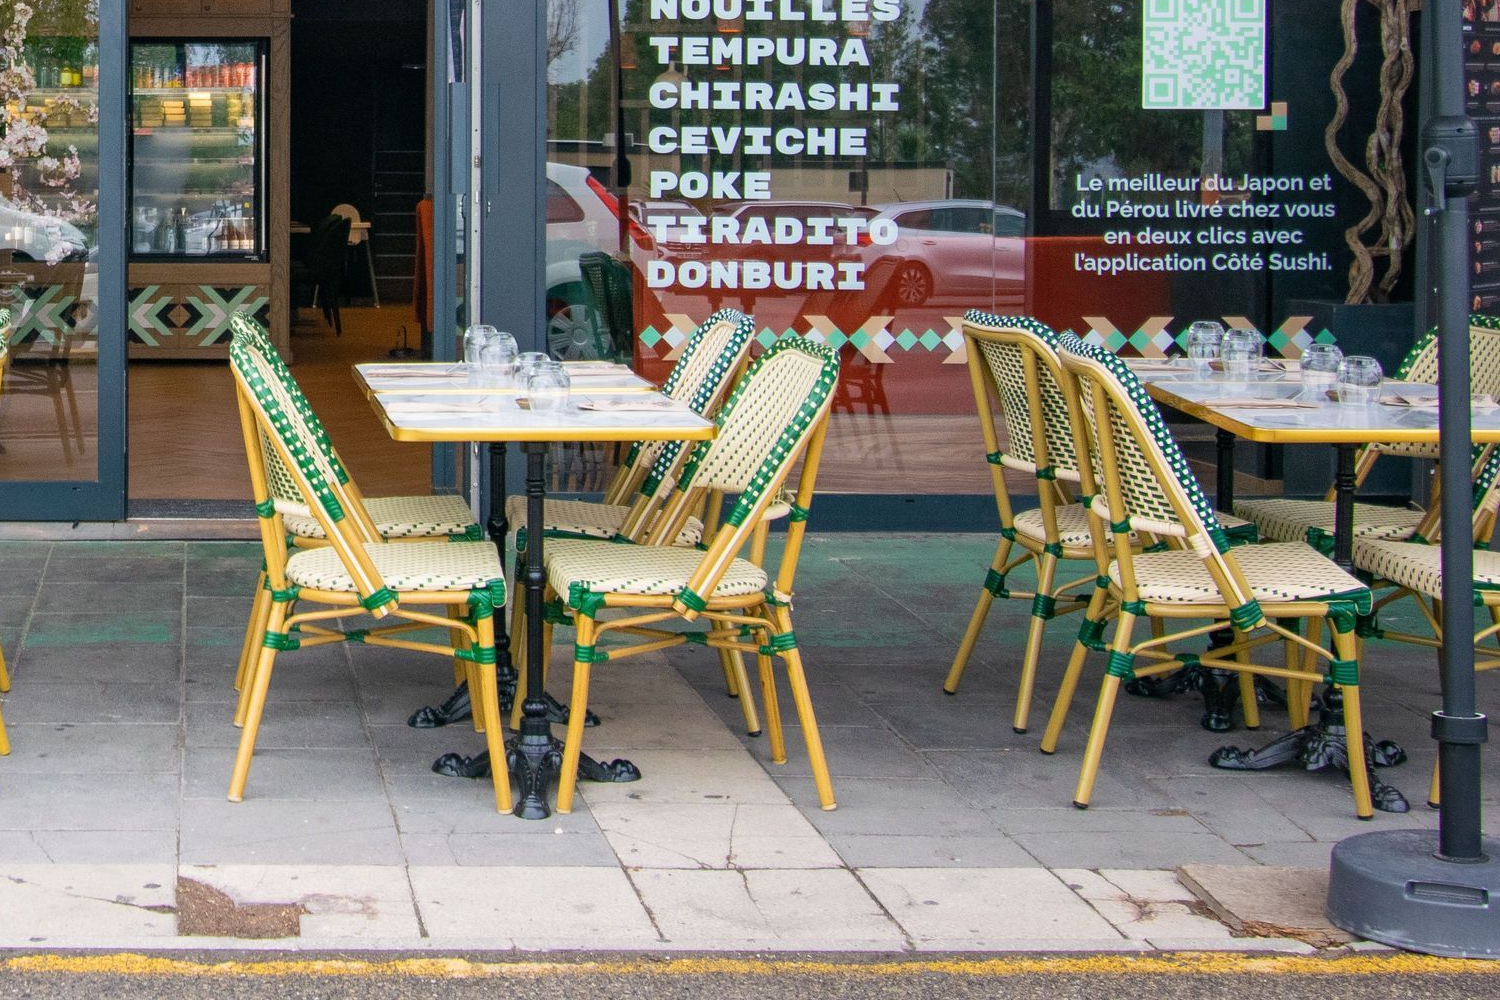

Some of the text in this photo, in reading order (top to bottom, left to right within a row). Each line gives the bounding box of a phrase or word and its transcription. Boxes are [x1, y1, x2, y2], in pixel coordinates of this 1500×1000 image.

[650, 37, 870, 66] TEMPURA
[649, 82, 899, 111] CHIRASHI
[649, 127, 867, 155] CEVICHE
[650, 171, 771, 199] POKE
[1076, 174, 1332, 195] Le meilleur du Japon et
[1072, 200, 1336, 218] du Pérou livré chez vous
[647, 216, 898, 245] TIRADITO
[1103, 227, 1304, 244] en deux clics avec
[647, 261, 865, 290] DONBURI
[1211, 253, 1264, 271] Côté
[1268, 253, 1333, 271] Sushi.
